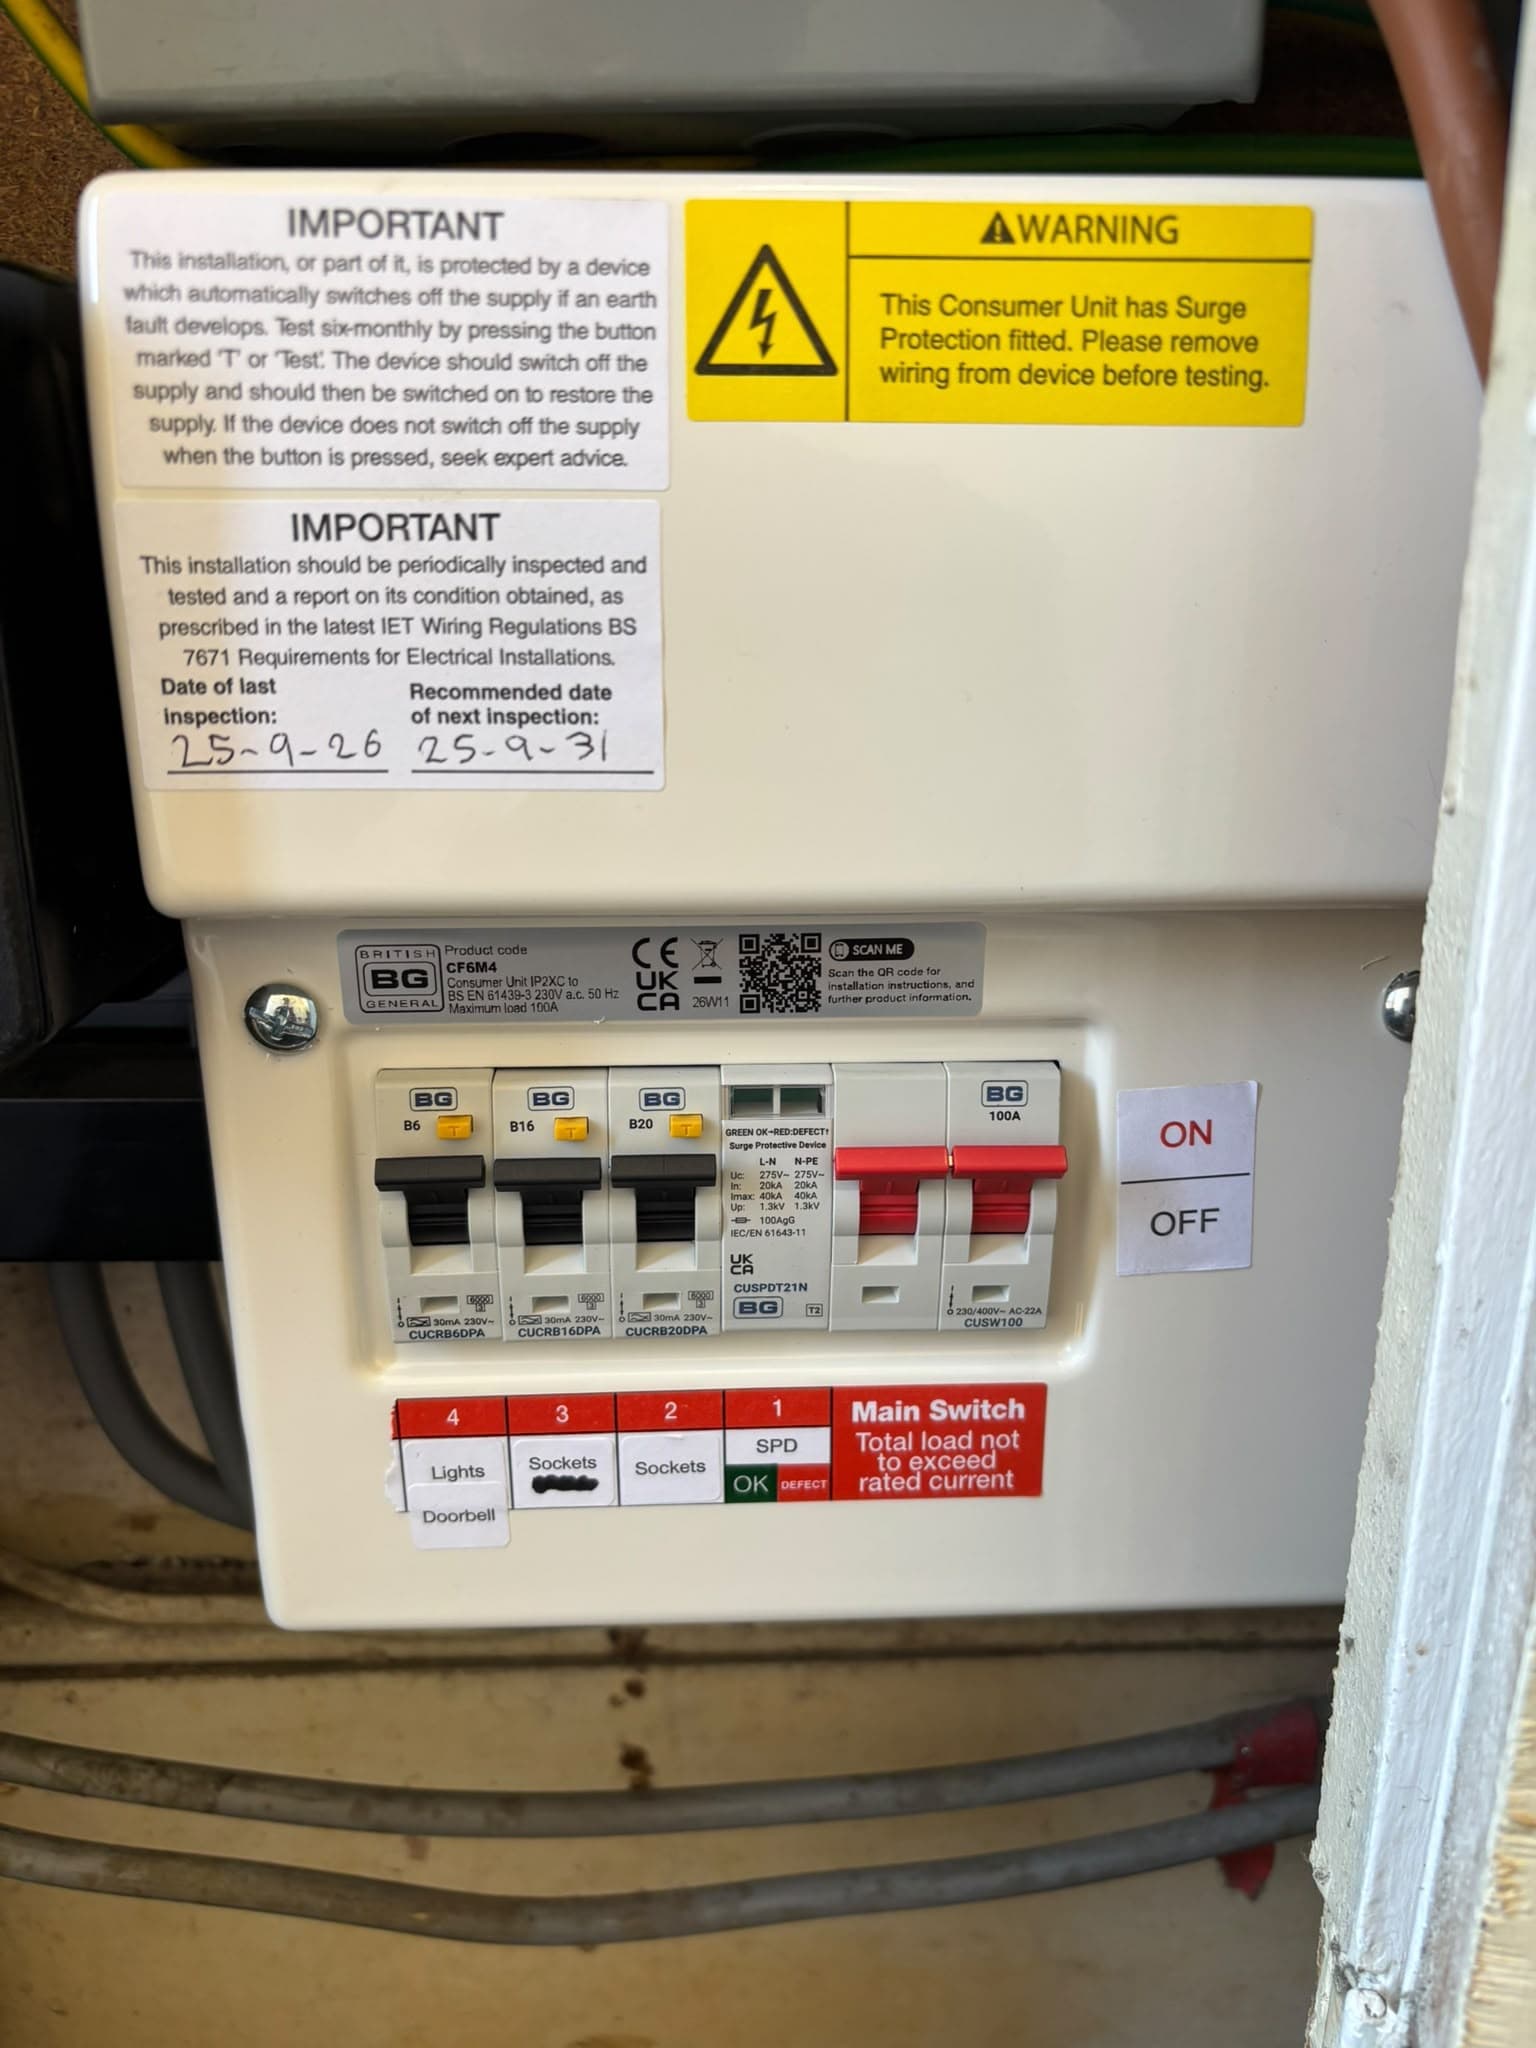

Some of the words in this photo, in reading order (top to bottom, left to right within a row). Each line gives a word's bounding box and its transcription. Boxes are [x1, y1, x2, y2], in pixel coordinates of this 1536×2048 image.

[289, 208, 504, 240] IMPORTANT
[1017, 214, 1178, 245] WARNING
[130, 249, 172, 270] This
[178, 252, 290, 273] installation,
[296, 256, 317, 272] or
[323, 255, 362, 276] part
[368, 254, 388, 273] of
[393, 254, 411, 275] it,
[418, 255, 434, 274] is
[440, 257, 532, 278] protected
[538, 257, 562, 280] by
[568, 261, 580, 275] a
[586, 258, 650, 276] device
[880, 293, 931, 316] This
[939, 293, 1064, 317] Consumer
[1071, 295, 1118, 318] Unit
[1126, 296, 1168, 318] has
[1176, 295, 1247, 325] Surge
[881, 327, 1000, 350] Protection
[1008, 328, 1072, 352] fitted.
[1082, 329, 1163, 352] Please
[1171, 335, 1259, 353] remove
[880, 361, 950, 389] wiring
[957, 362, 1010, 384] from
[1018, 363, 1095, 386] device
[1103, 364, 1178, 386] before
[1185, 364, 1269, 393] testing.
[292, 513, 501, 542] IMPORTANT
[139, 555, 182, 574] This
[188, 556, 291, 574] installation
[297, 556, 361, 574] should
[367, 555, 391, 573] be
[398, 556, 506, 578] periodically
[512, 555, 604, 577] inspected
[611, 556, 647, 574] and
[161, 678, 207, 695] Date
[213, 678, 233, 695] of
[240, 678, 276, 694] last
[410, 683, 562, 700] Recommended
[569, 684, 612, 701] date
[164, 707, 276, 728] inspection:
[411, 707, 431, 724] of
[438, 709, 480, 724] next
[487, 707, 598, 729] inspection:
[172, 728, 381, 768] 25-9-26
[418, 730, 606, 764] 25-9-31
[360, 949, 436, 959] BRITISH
[445, 945, 493, 956] Product
[498, 945, 527, 955] code
[853, 944, 882, 955] SCAN
[886, 944, 903, 954] ME
[446, 962, 497, 973] CF6M4
[829, 969, 854, 977] Scan
[858, 969, 874, 977] the
[878, 968, 894, 976] QR
[897, 968, 923, 976] code
[927, 967, 941, 975] for
[371, 969, 428, 989] BG
[447, 977, 503, 988] Consumer
[506, 976, 527, 988] Unit
[531, 976, 565, 987] IP2XC
[568, 977, 578, 986] to
[637, 972, 678, 990] UK
[829, 981, 884, 991] installation
[888, 980, 951, 990] instructions,
[955, 979, 974, 988] and
[448, 991, 464, 1001] BS
[468, 990, 484, 1000] EN
[488, 990, 531, 1000] 61439-3
[535, 990, 562, 1000] 230V
[566, 990, 584, 999] a.c.
[588, 989, 600, 999] 50
[605, 989, 619, 999] Hz
[637, 993, 679, 1011] CA
[693, 997, 729, 1007] 26W11
[865, 994, 906, 1004] product
[909, 993, 971, 1002] information.
[367, 999, 439, 1009] GENERAL
[449, 1003, 501, 1014] Maximum
[504, 1002, 527, 1013] load
[531, 1001, 559, 1012] 100A
[415, 1092, 453, 1107] BG
[532, 1092, 570, 1106] BG
[644, 1093, 681, 1106] BG
[986, 1086, 1023, 1101] BG
[990, 1111, 1021, 1121] 100A
[404, 1120, 420, 1131] B6
[510, 1120, 534, 1132] B16
[630, 1119, 653, 1129] B20
[1160, 1119, 1212, 1148] ON
[729, 1142, 753, 1151] Surge
[760, 1157, 776, 1166] L-N
[795, 1157, 818, 1165] N-PE
[731, 1182, 741, 1190] In:
[760, 1192, 782, 1200] 40kA
[760, 1217, 795, 1225] 100AgG
[1151, 1208, 1220, 1236] OFF
[731, 1229, 762, 1237] IEC/EN
[765, 1229, 805, 1237] 61643-11
[731, 1255, 753, 1264] UK
[731, 1265, 753, 1275] CA
[734, 1283, 807, 1293] CUSPDT21N
[739, 1302, 778, 1314] BG
[809, 1306, 820, 1315] T2
[1009, 1307, 1042, 1315] AC-22A
[654, 1314, 680, 1322] 30mA
[964, 1317, 1023, 1327] CUSW100
[409, 1328, 485, 1340] CUCRB6DPA
[518, 1326, 600, 1337] CUCRB16DPA
[626, 1326, 708, 1338] CUCRB20DPA
[556, 1406, 569, 1423] 3
[664, 1402, 677, 1420] 2
[773, 1400, 782, 1416] 1
[852, 1401, 919, 1423] Main
[929, 1398, 1025, 1422] Switch
[446, 1409, 460, 1426] 4
[757, 1438, 797, 1453] SPD
[856, 1432, 913, 1453] Total
[921, 1430, 973, 1450] load
[981, 1430, 1019, 1449] not
[529, 1456, 597, 1470] Sockets
[635, 1460, 706, 1475] Sockets
[878, 1454, 901, 1472] to
[909, 1451, 996, 1471] exceed
[432, 1465, 485, 1482] Lights
[733, 1476, 768, 1493] OK
[781, 1479, 828, 1490] DEFECT
[859, 1472, 920, 1492] rated
[929, 1471, 1014, 1489] current
[423, 1508, 495, 1523] Doorbell
